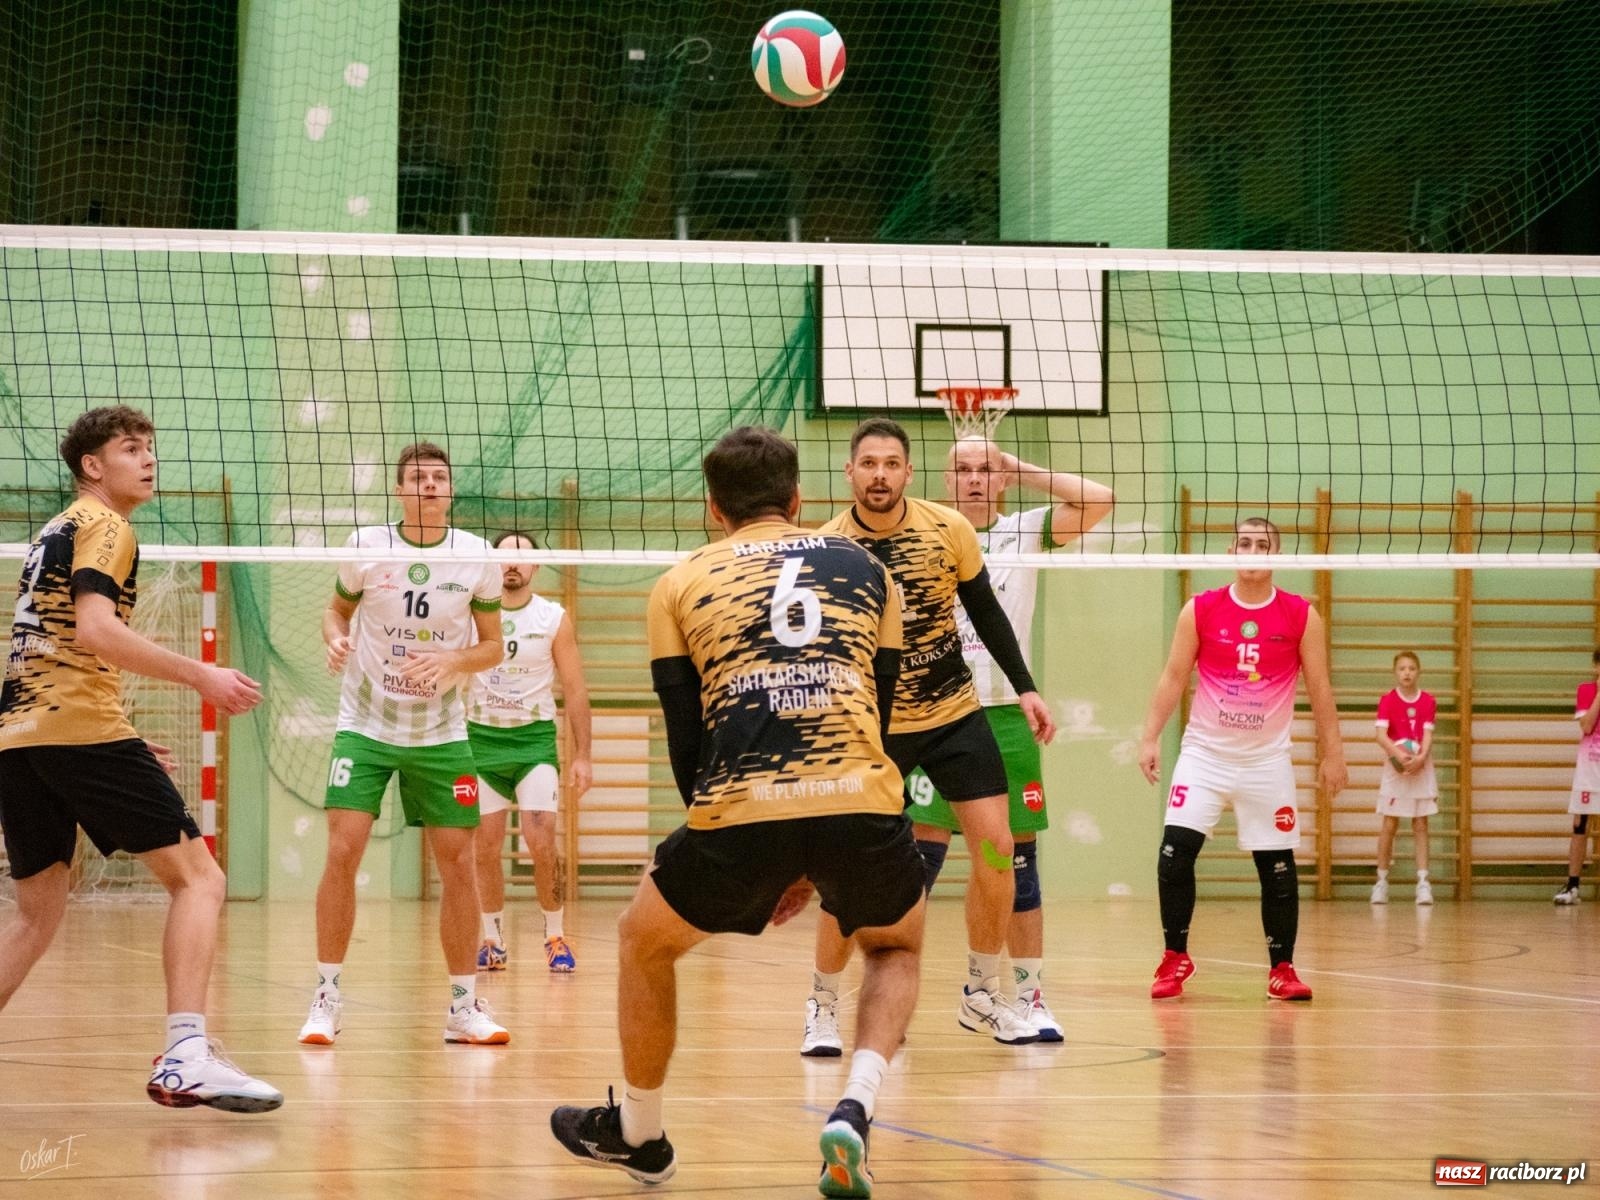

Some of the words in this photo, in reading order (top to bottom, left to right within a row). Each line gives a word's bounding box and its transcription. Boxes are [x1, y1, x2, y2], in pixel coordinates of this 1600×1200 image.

[732, 536, 828, 556] HARAZIM
[403, 590, 429, 619] 16
[770, 557, 822, 648] 6
[383, 625, 445, 642] VISON
[507, 640, 518, 660] 9
[1236, 643, 1260, 665] 15
[384, 685, 436, 698] TECHNOLOGY
[769, 688, 832, 712] RADLIN
[1218, 710, 1265, 724] PIVEXIN
[328, 757, 353, 788] 16
[752, 785, 773, 801] WE
[775, 782, 807, 799] PLAY
[809, 780, 836, 797] FOR
[839, 777, 864, 794] FUN
[910, 774, 935, 807] 19
[1168, 785, 1189, 808] 15
